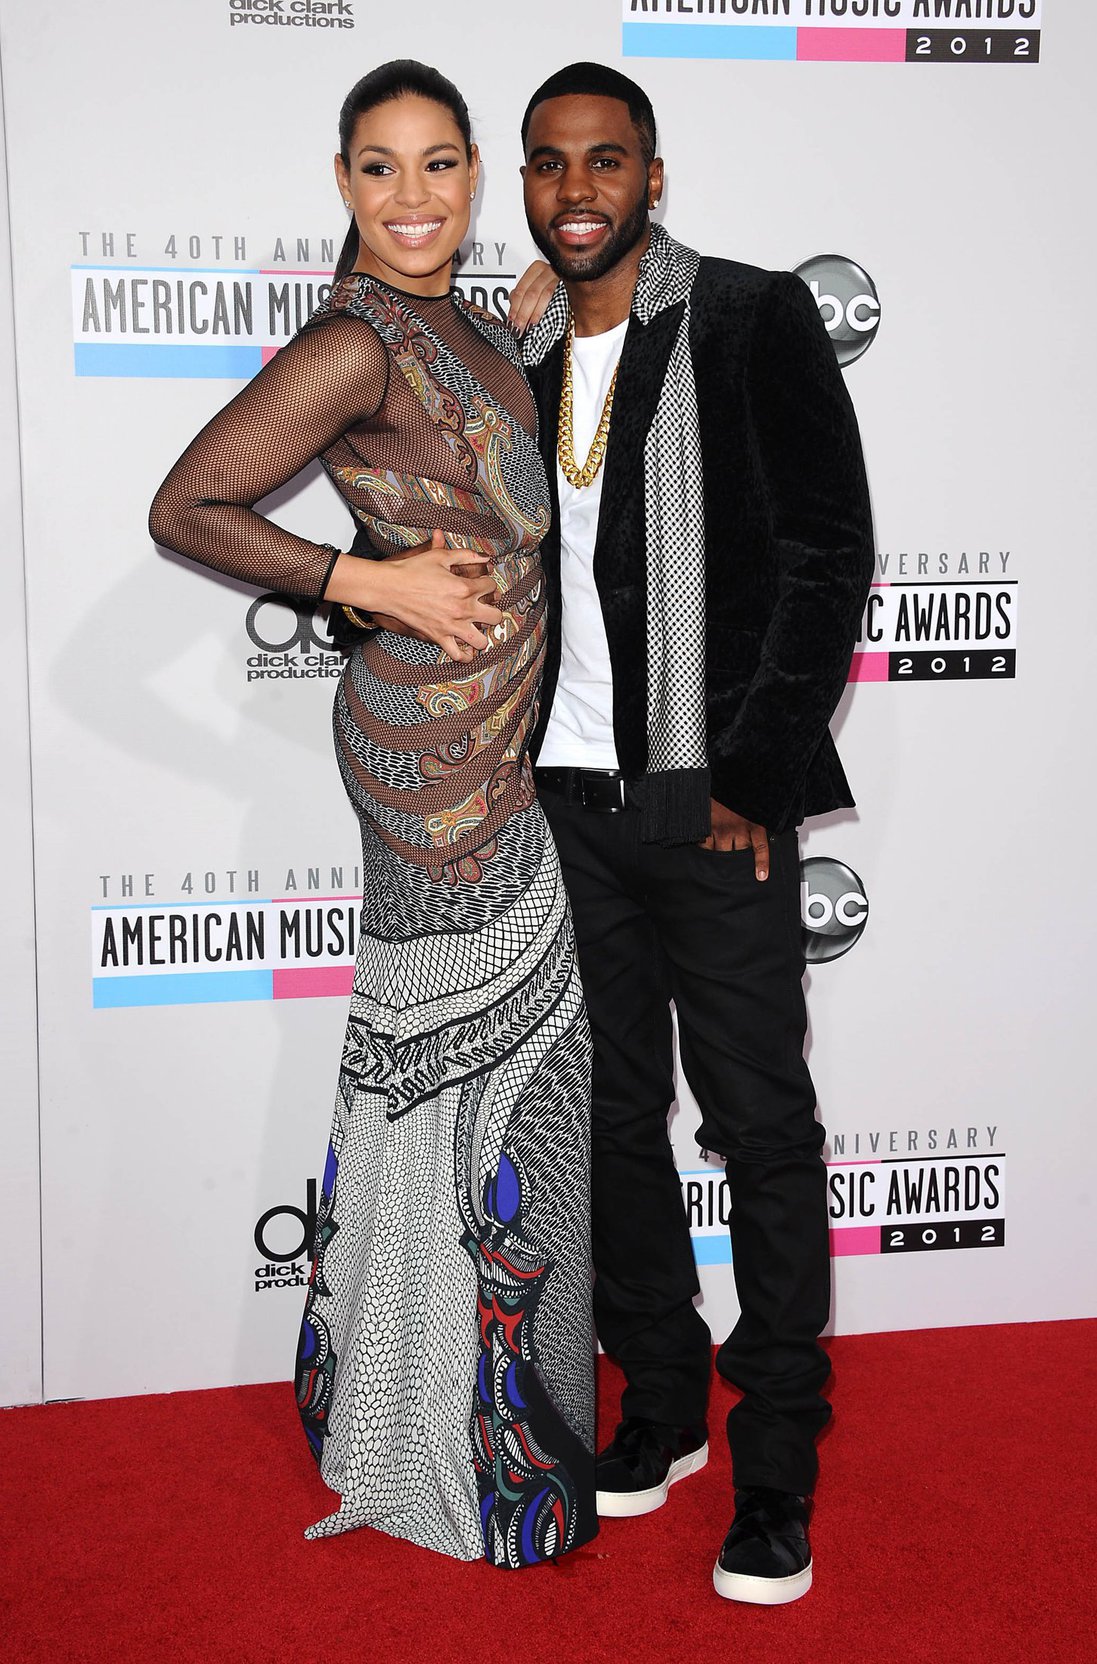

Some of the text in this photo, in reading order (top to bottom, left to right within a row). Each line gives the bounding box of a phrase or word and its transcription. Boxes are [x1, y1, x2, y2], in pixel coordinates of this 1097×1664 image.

[290, 0, 354, 15] clark
[229, 12, 355, 29] productions
[915, 36, 1030, 55] 2012
[78, 231, 137, 258] THE
[164, 234, 246, 261] 40TH
[81, 277, 253, 335] AMERICAN
[878, 551, 1010, 575] VERSARY
[894, 592, 1012, 642] AWARDS
[246, 653, 299, 667] dick
[898, 656, 1007, 674] 2012
[99, 866, 359, 898] THE 40TH ANNI
[101, 907, 355, 967] AMERICAN MUSI
[829, 1171, 875, 1219] SIC
[886, 1164, 1000, 1216] AWARDS
[889, 1225, 996, 1247] 2012
[255, 1262, 305, 1277] dick
